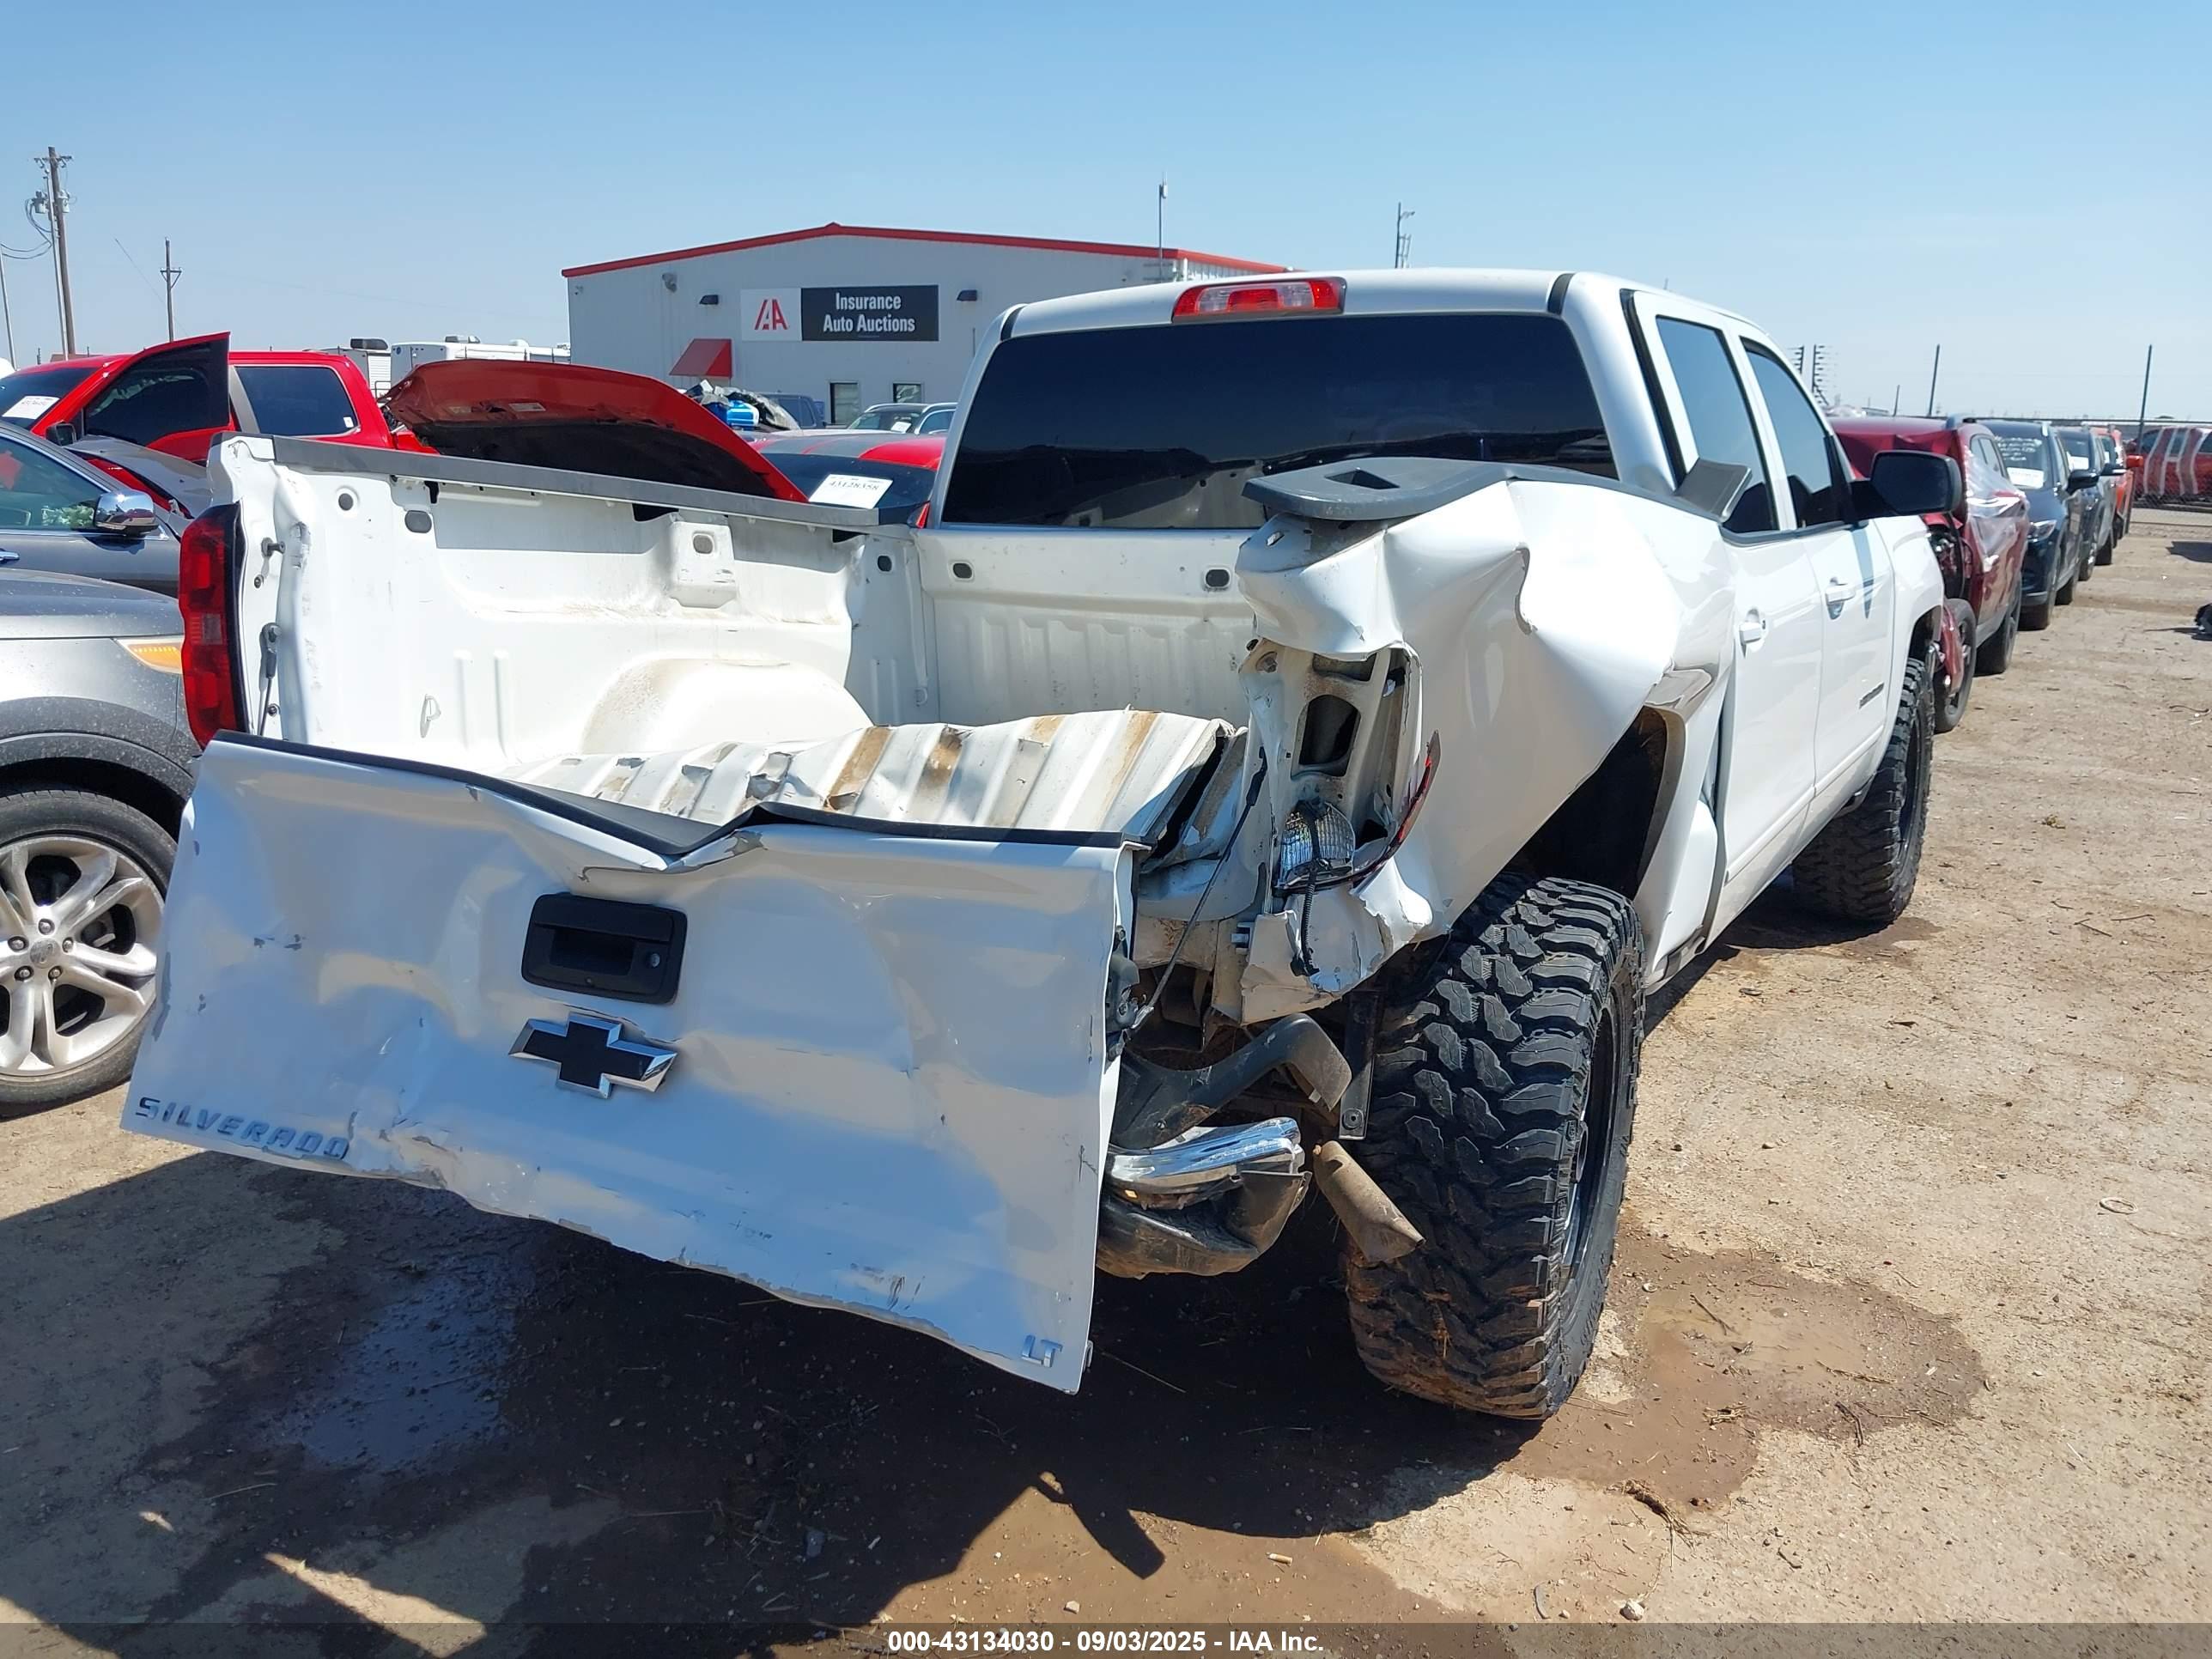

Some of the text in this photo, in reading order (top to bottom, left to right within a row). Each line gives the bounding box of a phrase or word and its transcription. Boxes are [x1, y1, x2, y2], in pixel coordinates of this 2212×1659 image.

[836, 292, 902, 310] Insurance
[823, 313, 915, 332] Auto Auctions
[135, 1097, 350, 1159] SILVERADO
[1021, 1334, 1063, 1367] LT
